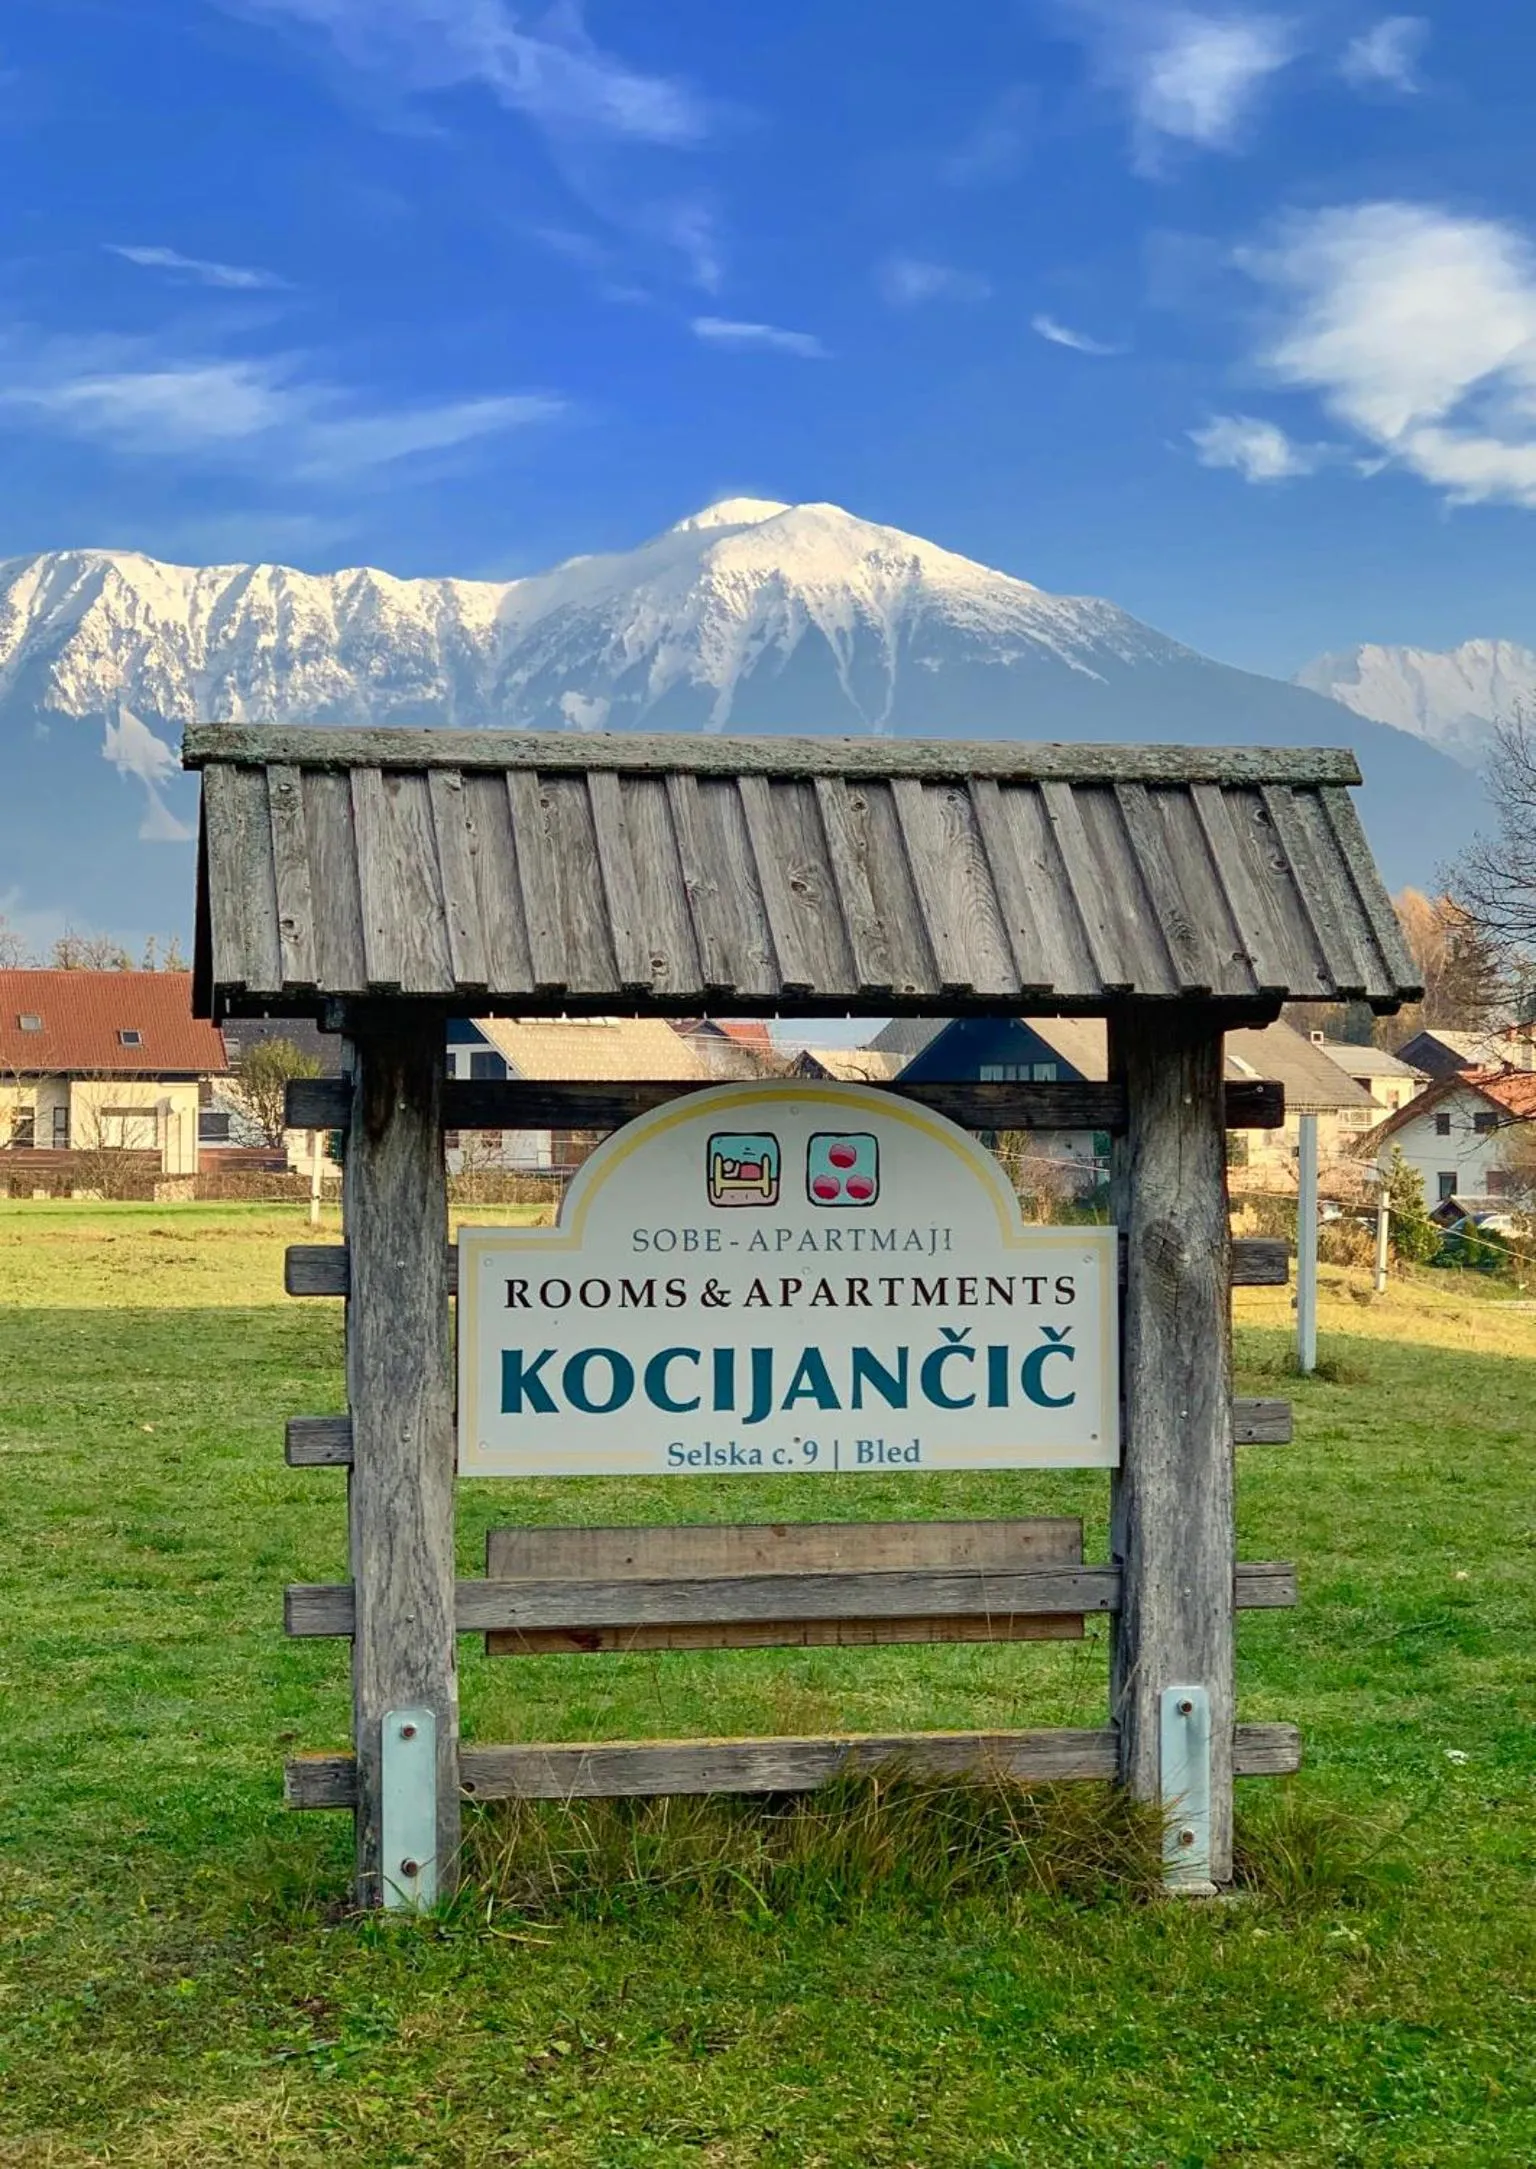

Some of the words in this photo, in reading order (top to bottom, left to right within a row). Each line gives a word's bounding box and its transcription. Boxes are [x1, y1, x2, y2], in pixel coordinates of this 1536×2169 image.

[632, 1228, 723, 1253] SOBE
[747, 1227, 953, 1257] APARTMAJI
[503, 1277, 688, 1309] ROOMS
[700, 1277, 732, 1308] &
[742, 1275, 1077, 1308] APARTMENTS
[500, 1325, 1078, 1426] KOCIJANČIČ
[666, 1440, 764, 1467] Selska
[771, 1447, 794, 1466] c.
[802, 1439, 819, 1466] 9
[855, 1438, 923, 1465] Bled
